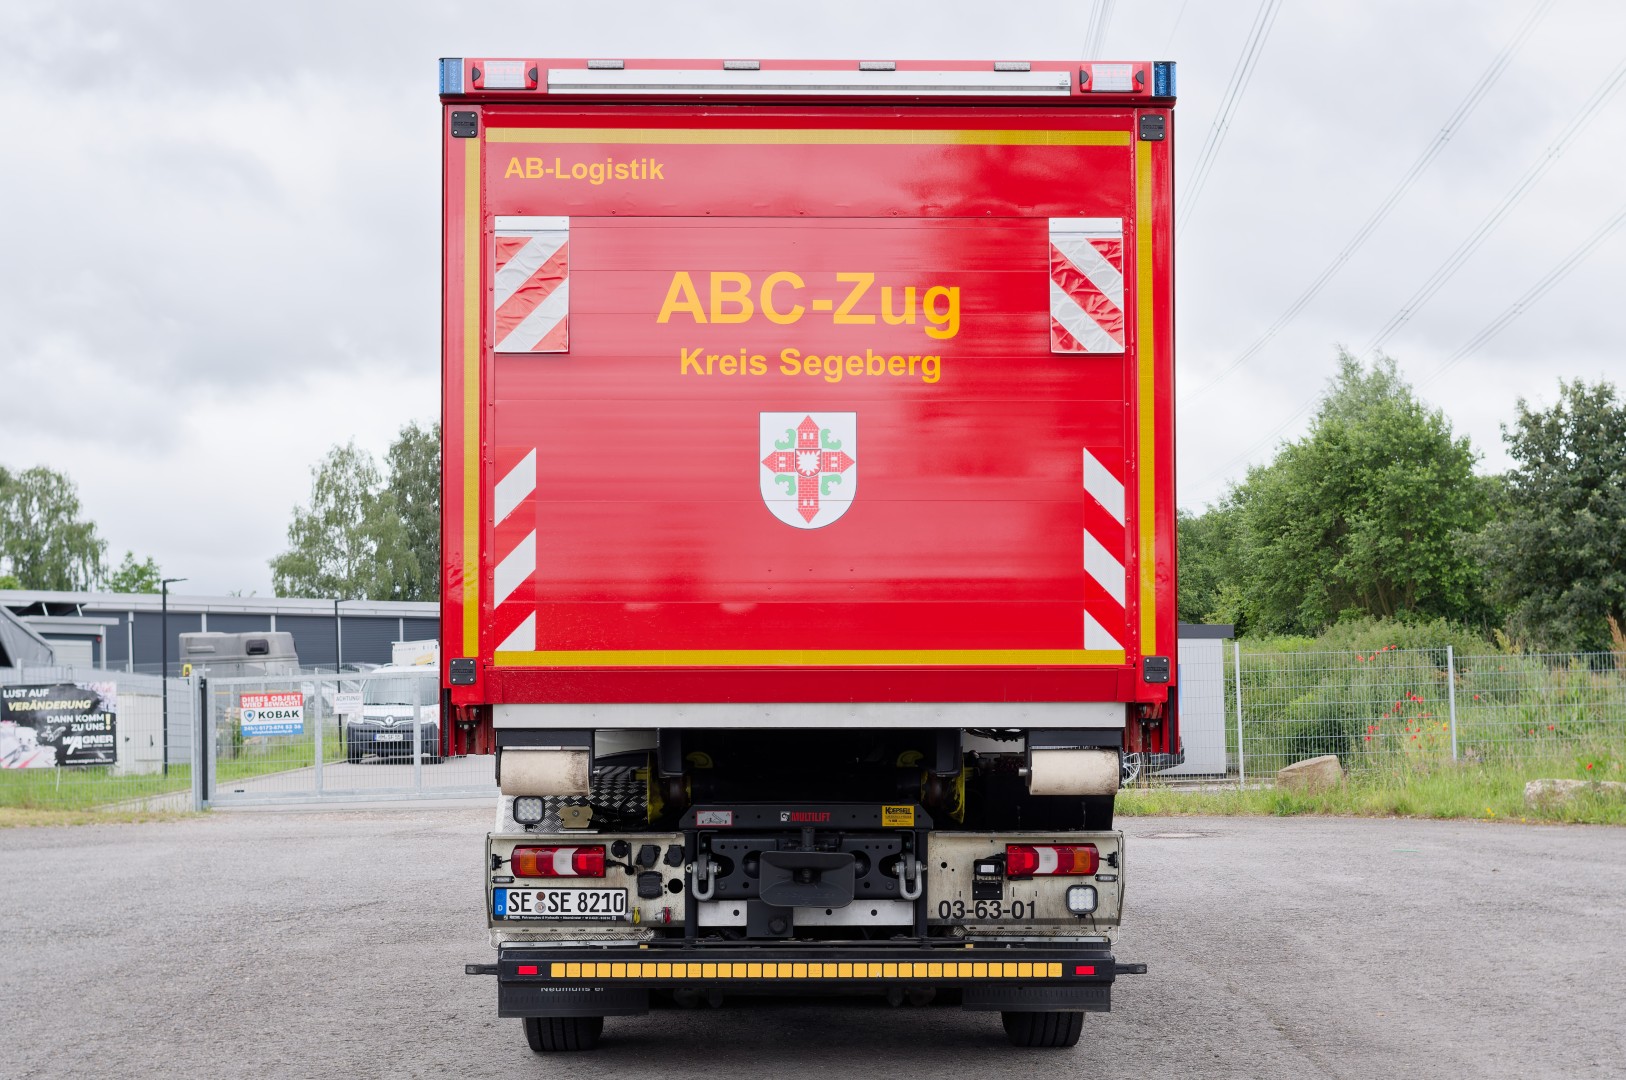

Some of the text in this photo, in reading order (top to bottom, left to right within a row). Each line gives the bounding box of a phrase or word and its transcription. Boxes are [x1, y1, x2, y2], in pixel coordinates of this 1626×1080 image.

[504, 157, 665, 185] AB-Logistik
[656, 271, 960, 340] ABC-Zug
[680, 348, 942, 384] Kreis Segeberg
[3, 689, 49, 698] LUST AUF
[270, 694, 301, 702] OBJEKT
[8, 699, 91, 712] VERÄNDERUNG
[46, 715, 75, 724] DANN
[75, 714, 104, 722] KOMM
[258, 710, 300, 719] KOBAK
[71, 723, 105, 732] ZU UNS
[62, 734, 114, 755] WAGNER
[791, 811, 831, 822] MULTILIFT
[508, 892, 532, 913] SE
[547, 892, 571, 913] SE
[577, 892, 625, 913] 8210
[938, 900, 1035, 920] 03-63-01
